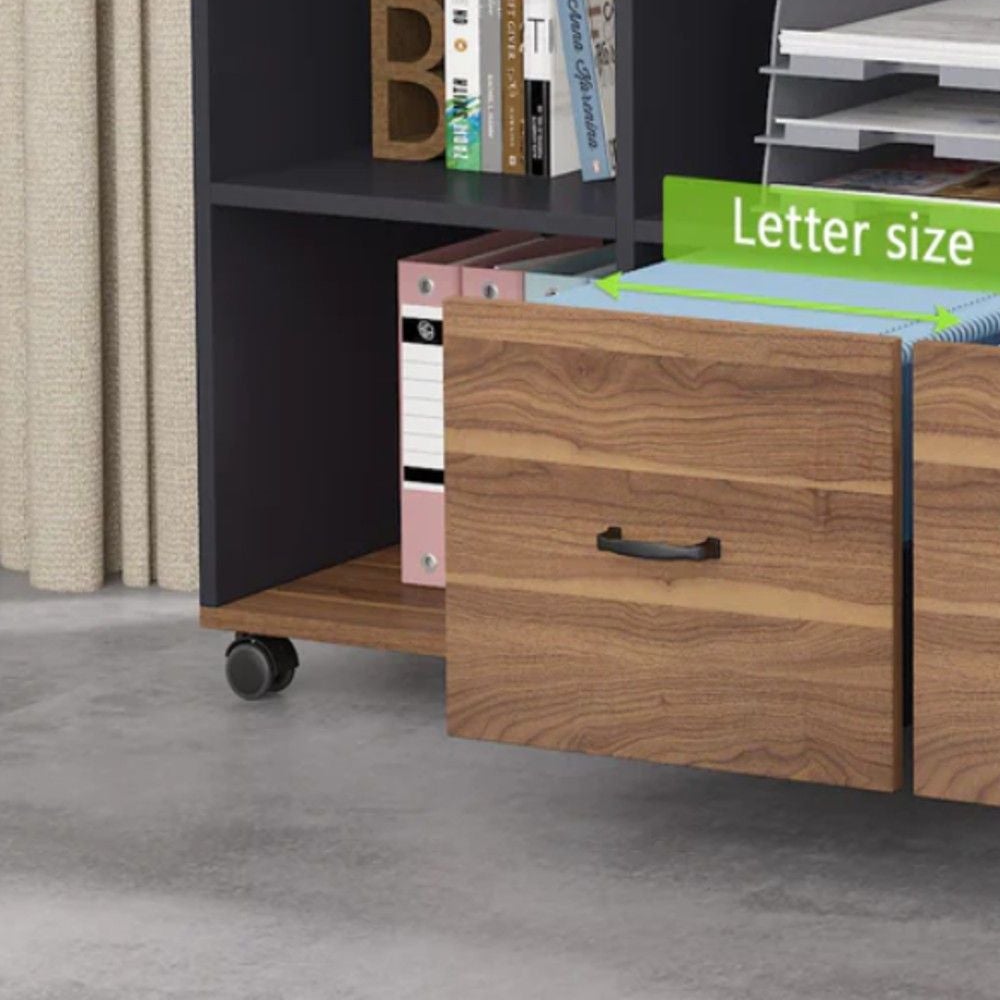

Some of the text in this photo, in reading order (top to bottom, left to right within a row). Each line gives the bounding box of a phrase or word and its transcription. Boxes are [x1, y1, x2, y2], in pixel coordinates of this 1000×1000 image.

[453, 9, 468, 25] ON
[506, 21, 516, 59] GIVER
[574, 59, 598, 150] Karenina
